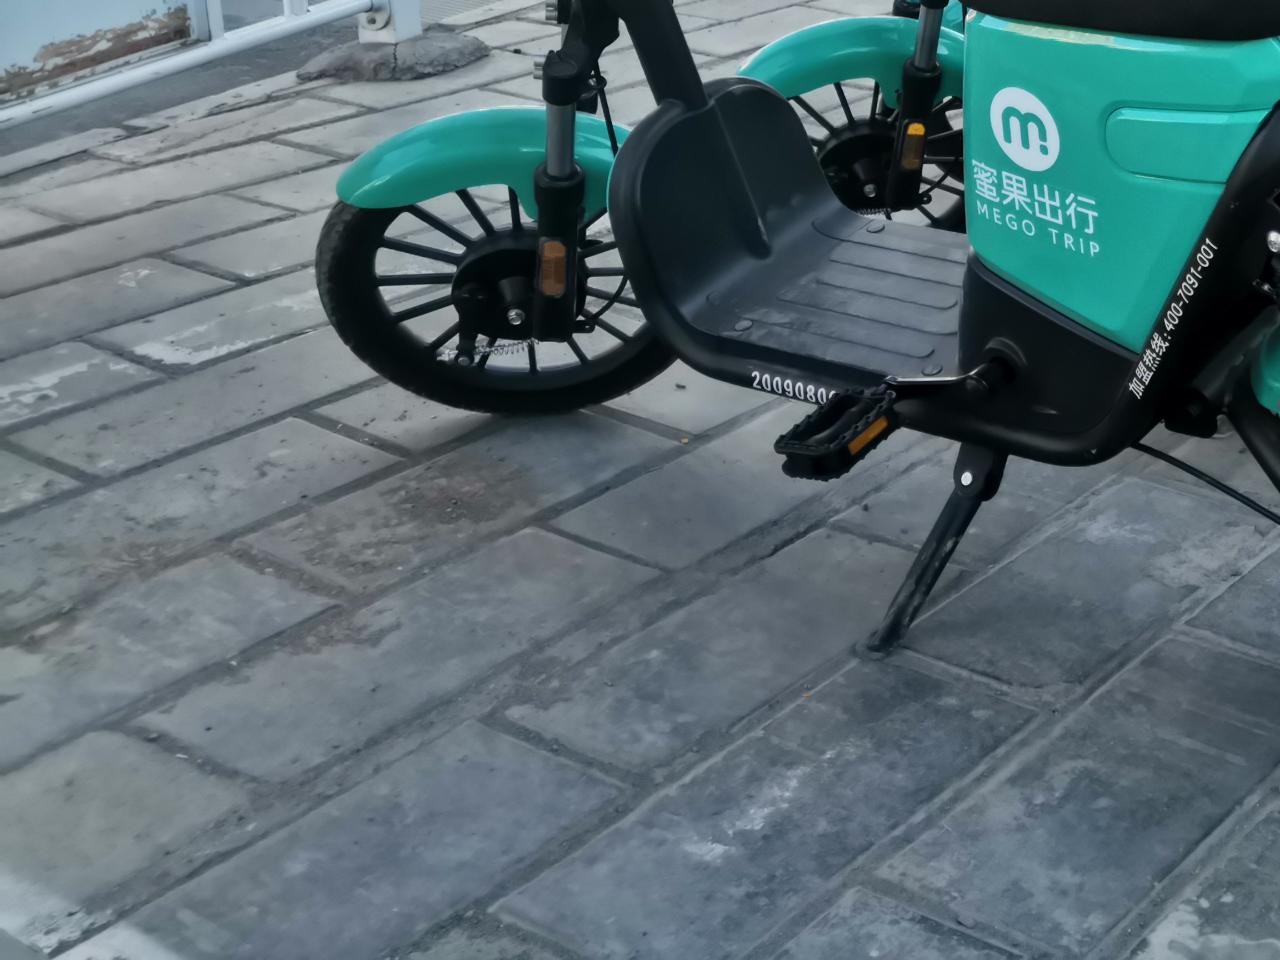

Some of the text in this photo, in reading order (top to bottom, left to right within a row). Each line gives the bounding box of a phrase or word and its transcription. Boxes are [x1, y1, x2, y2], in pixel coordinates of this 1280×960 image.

[971, 159, 1099, 234] 蜜果出行
[975, 199, 1101, 257] MEGO TRIP
